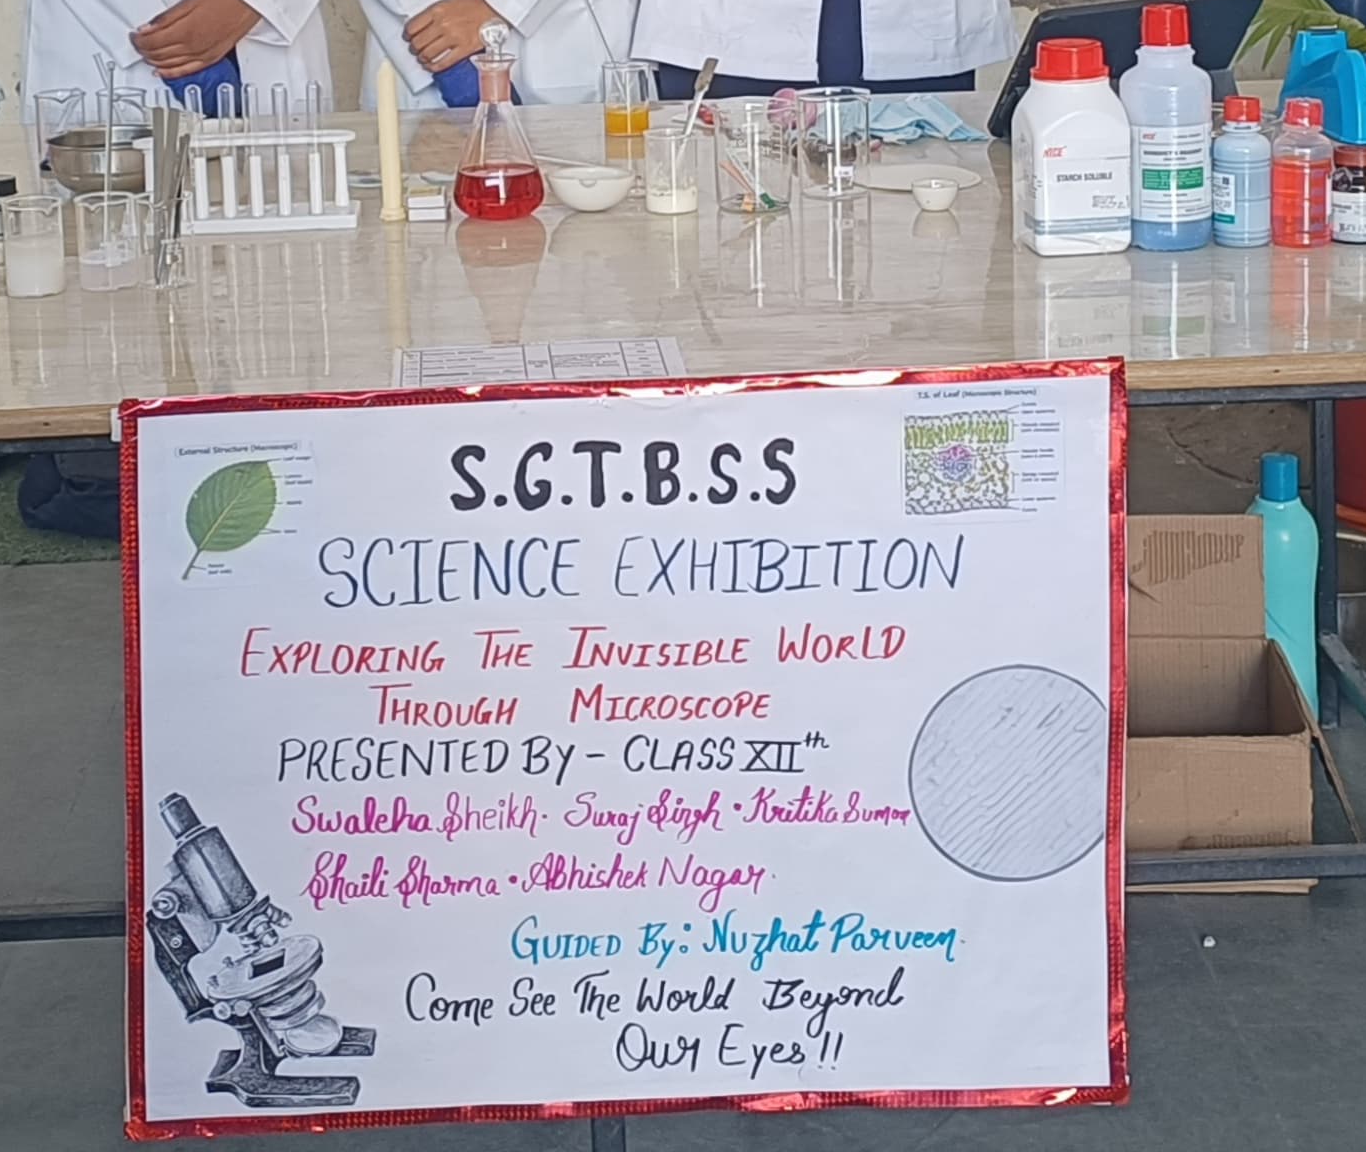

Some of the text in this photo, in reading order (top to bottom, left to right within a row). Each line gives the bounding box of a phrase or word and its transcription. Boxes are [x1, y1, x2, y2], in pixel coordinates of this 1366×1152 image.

[1056, 171, 1113, 183] STARCH SOLUBLE
[943, 389, 960, 398] Leaf
[213, 445, 248, 455] Structure
[449, 437, 797, 512] S.G.T.B.S.S
[319, 533, 965, 609] SCIENCE EXHIBITION
[240, 623, 907, 677] EXPLORING THE INVISIBLE WORLD
[368, 681, 772, 728] THROUGH MICROSCOPE
[277, 737, 510, 785] PRESENTED
[622, 734, 735, 775] CLASS
[291, 794, 434, 835] Swaleha
[564, 791, 644, 846] Suraj
[743, 785, 840, 825] Kritika
[393, 855, 501, 909] Sharma
[521, 851, 647, 893] Abhishek
[511, 915, 622, 965] GUIDED
[702, 908, 824, 971] Nuzhat
[405, 966, 906, 1039] Come See The World Beyond
[615, 1022, 702, 1073] Our
